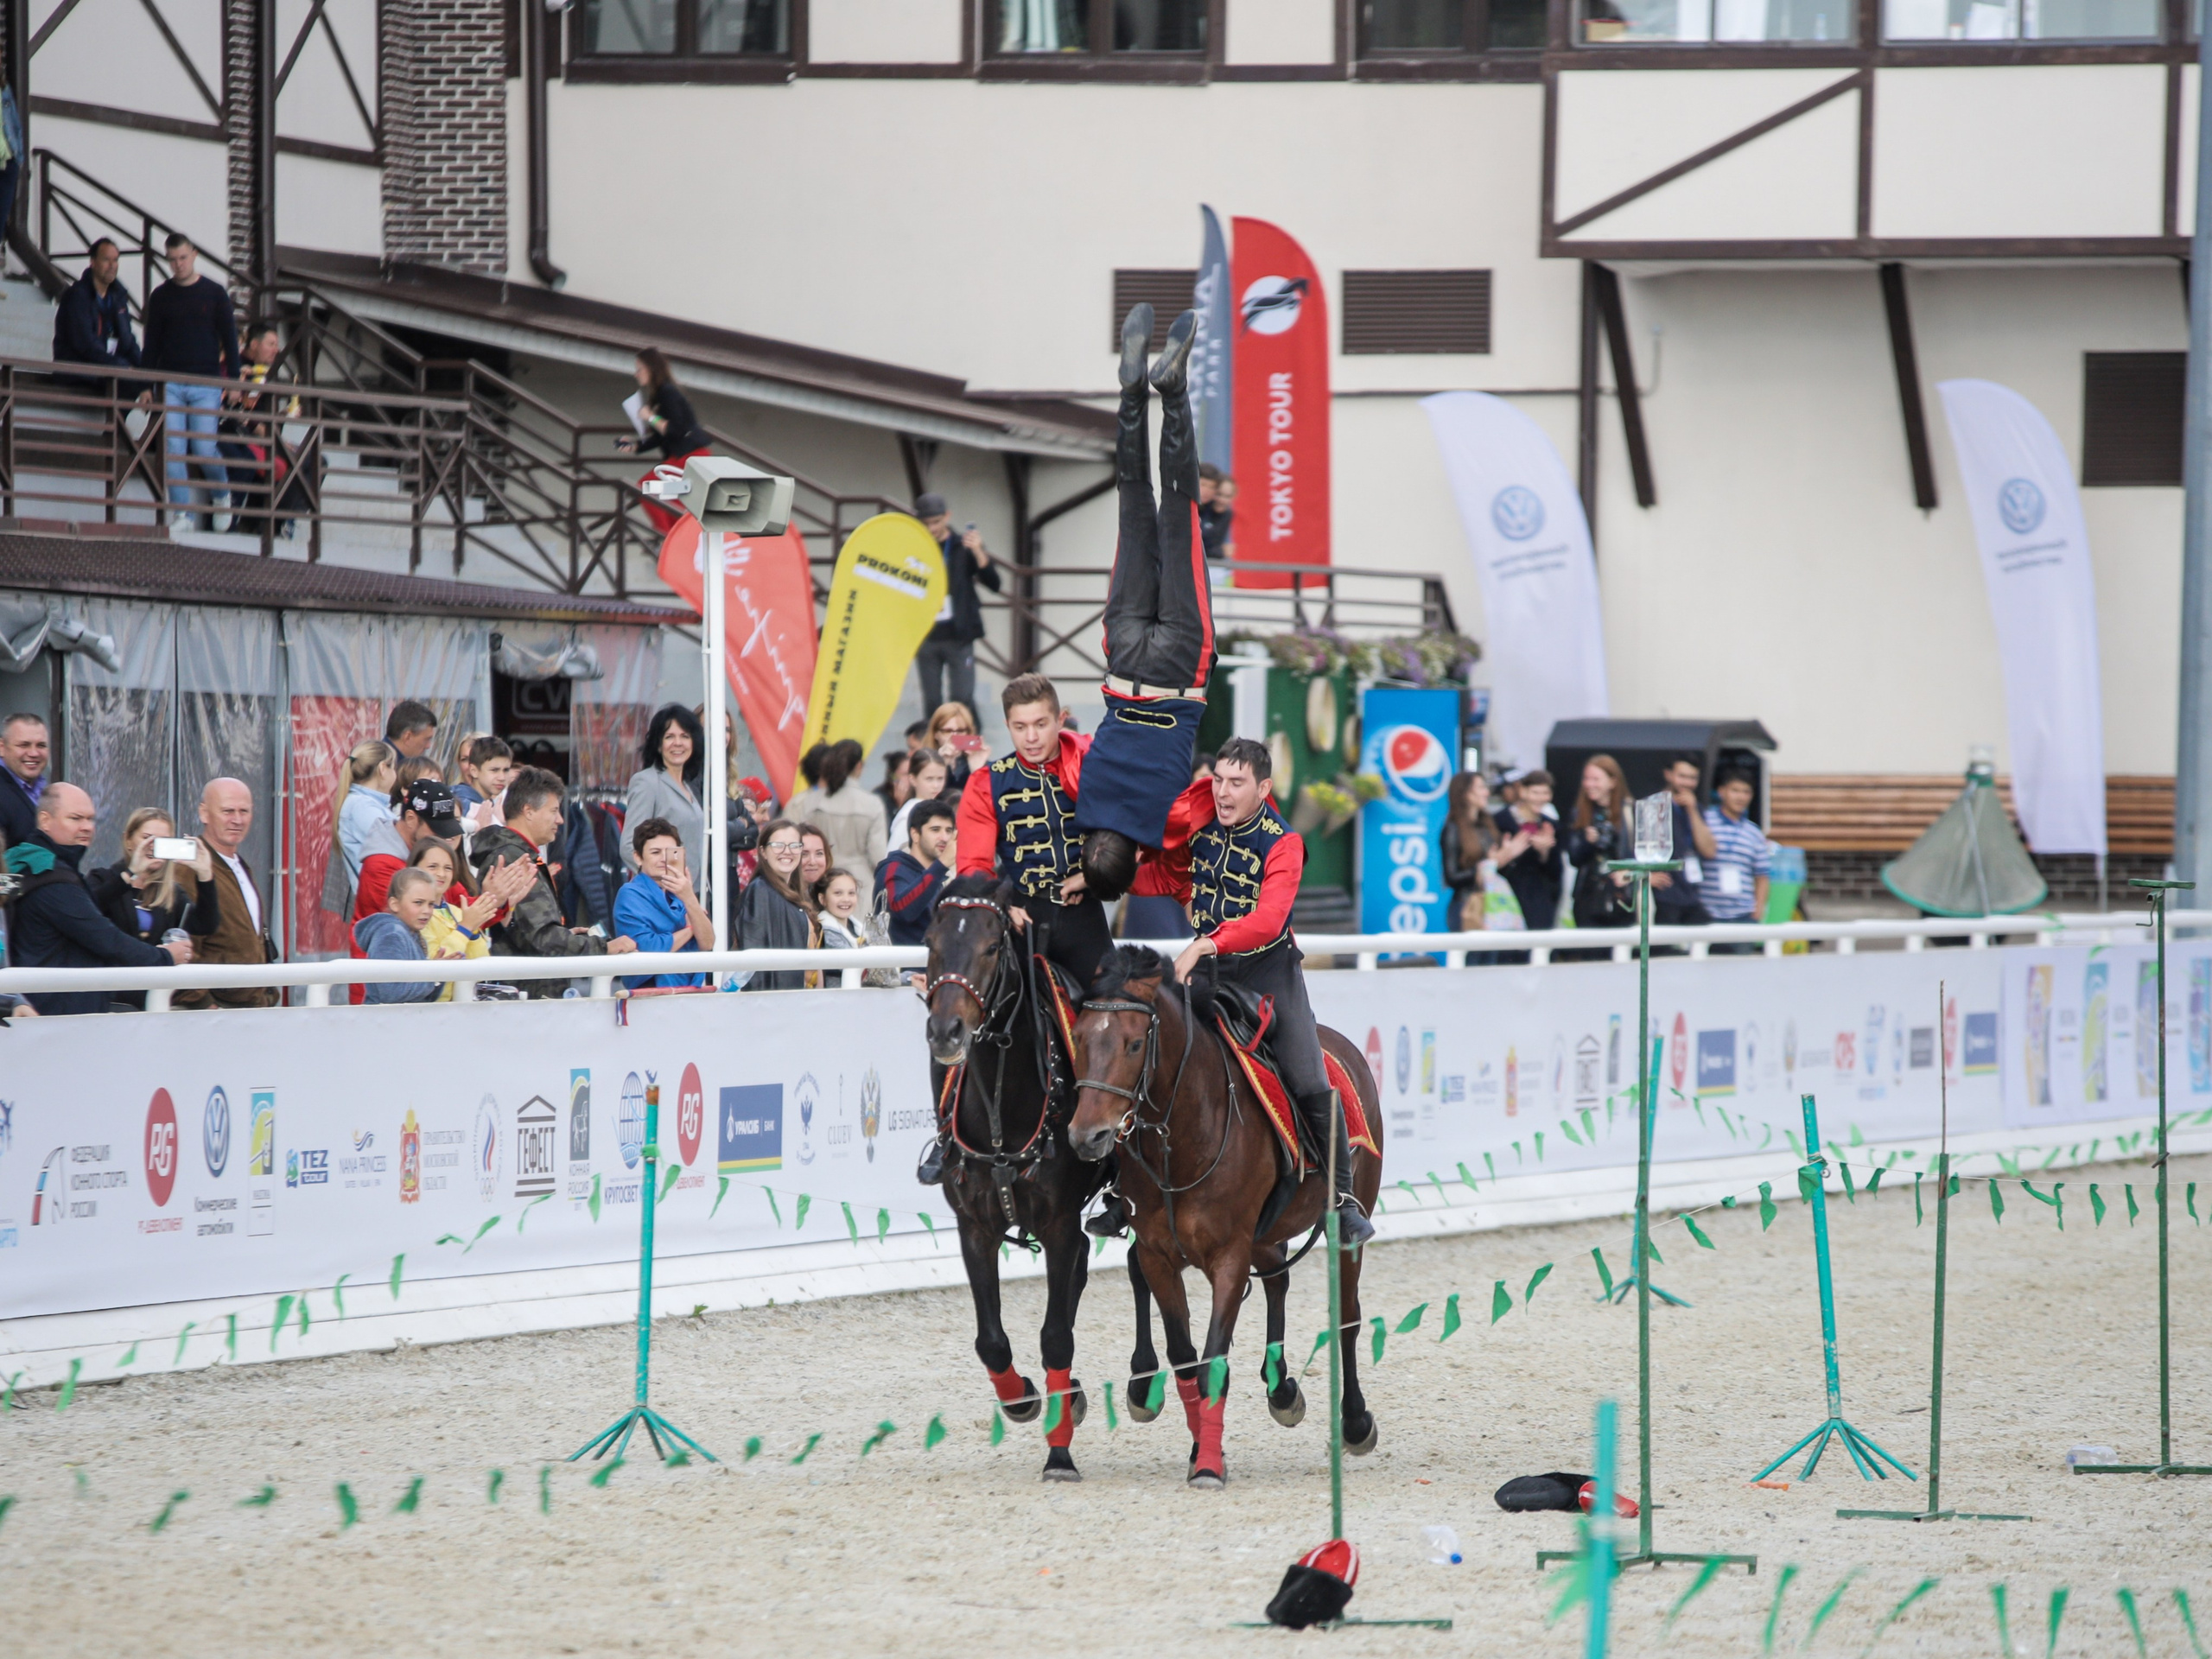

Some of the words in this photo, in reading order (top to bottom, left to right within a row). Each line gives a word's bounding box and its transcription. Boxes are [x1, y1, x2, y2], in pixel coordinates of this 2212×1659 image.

[1268, 371, 1293, 444] TOUR
[1269, 449, 1294, 542] TOKYO
[832, 588, 857, 675] МАГАЗИН
[1380, 821, 1438, 961] epsi
[518, 1127, 556, 1175] ГЕФЕСТ
[887, 1111, 897, 1132] LG
[301, 1149, 328, 1168] TEZ
[604, 1185, 639, 1205] КРУГОСВЕТ
